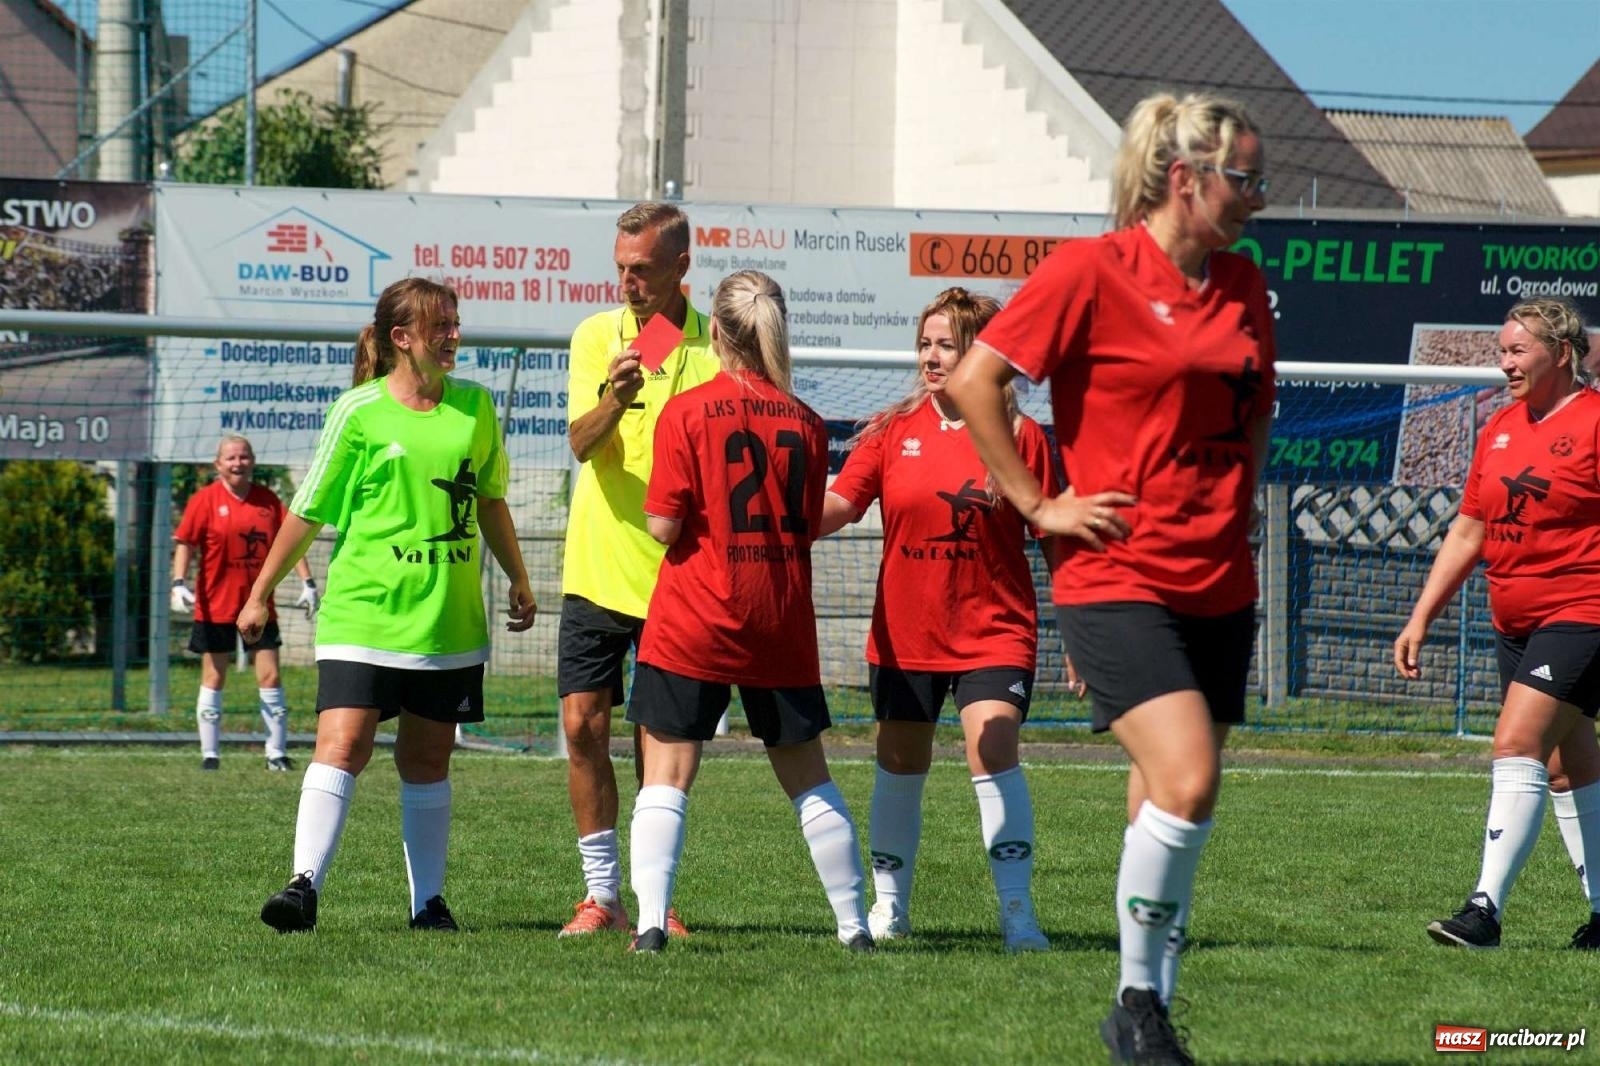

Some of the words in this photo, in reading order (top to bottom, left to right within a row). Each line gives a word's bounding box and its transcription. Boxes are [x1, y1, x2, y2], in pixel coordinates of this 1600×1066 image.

[0, 198, 96, 229] STWO
[696, 226, 731, 247] MR
[736, 227, 785, 249] BAU
[794, 229, 850, 250] Marcin
[856, 231, 905, 252] Rusek
[415, 244, 445, 268] tel.
[451, 245, 487, 269] 604
[493, 246, 529, 269] 507
[535, 247, 570, 271] 320
[731, 255, 787, 270] Budowlane
[962, 238, 1012, 276] 666
[1482, 242, 1600, 271] TWORKÓ
[239, 263, 349, 282] DAW-BUD
[522, 278, 541, 301] 18
[790, 288, 833, 303] budowa
[836, 288, 876, 304] domów
[1481, 275, 1501, 295] ul.
[1506, 276, 1598, 299] Ogrodowa
[786, 310, 849, 326] rzebudowa
[853, 311, 908, 329] budynków
[790, 331, 841, 347] ończenia
[221, 342, 321, 366] Docieplenia
[221, 380, 340, 403] Kompleksowe
[704, 400, 736, 418] LKS
[75, 416, 109, 442] 10
[1270, 437, 1320, 467] 742
[1329, 439, 1379, 468] 974
